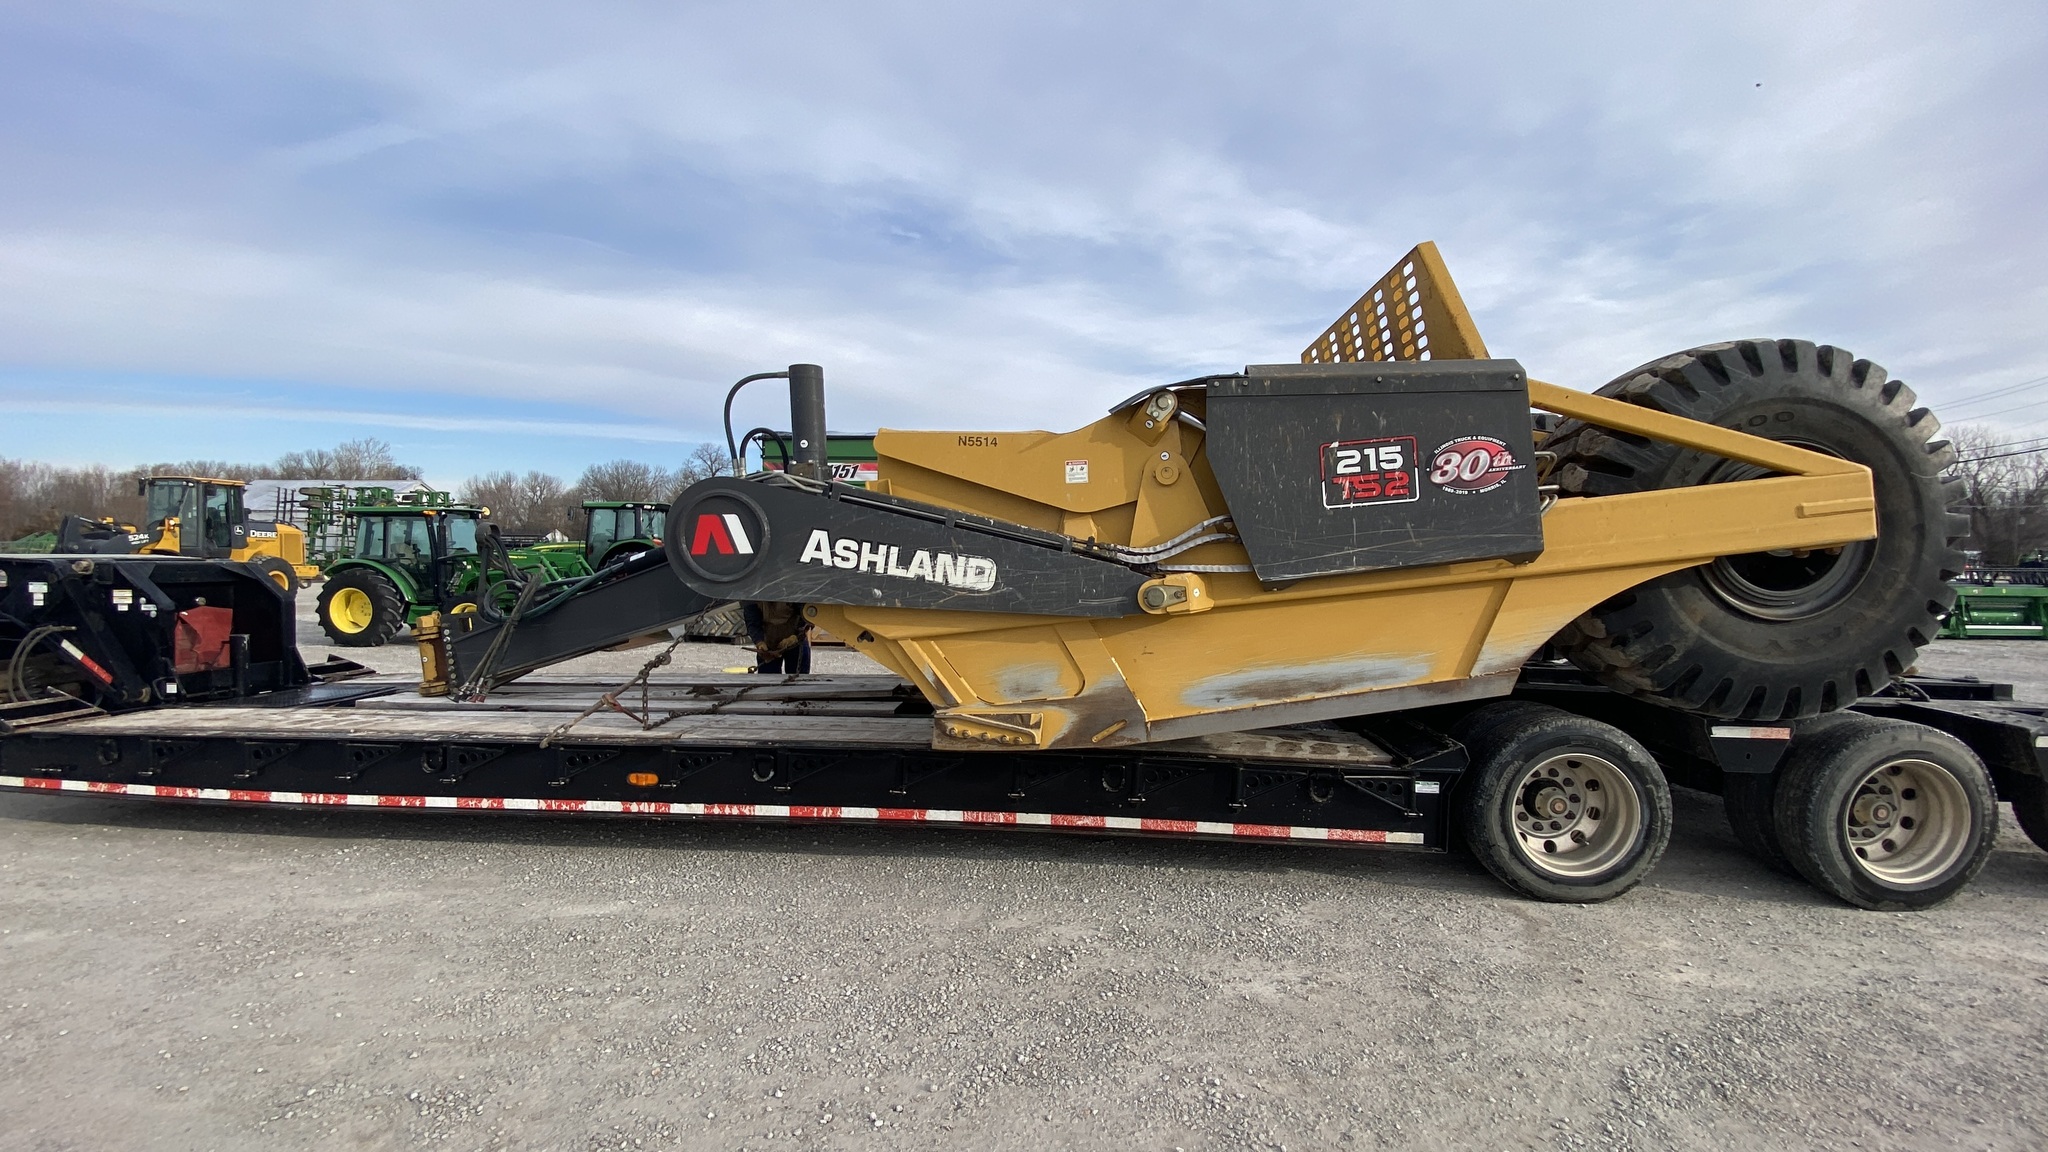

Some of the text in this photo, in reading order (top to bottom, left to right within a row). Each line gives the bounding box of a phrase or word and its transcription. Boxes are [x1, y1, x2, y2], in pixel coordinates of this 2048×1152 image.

[958, 436, 998, 447] N5514
[1454, 436, 1472, 444] TRUCK
[1478, 435, 1507, 447] EQUIPMENT
[1336, 445, 1404, 474] 215
[250, 530, 278, 539] DEERE
[800, 529, 997, 592] ASHLAND
